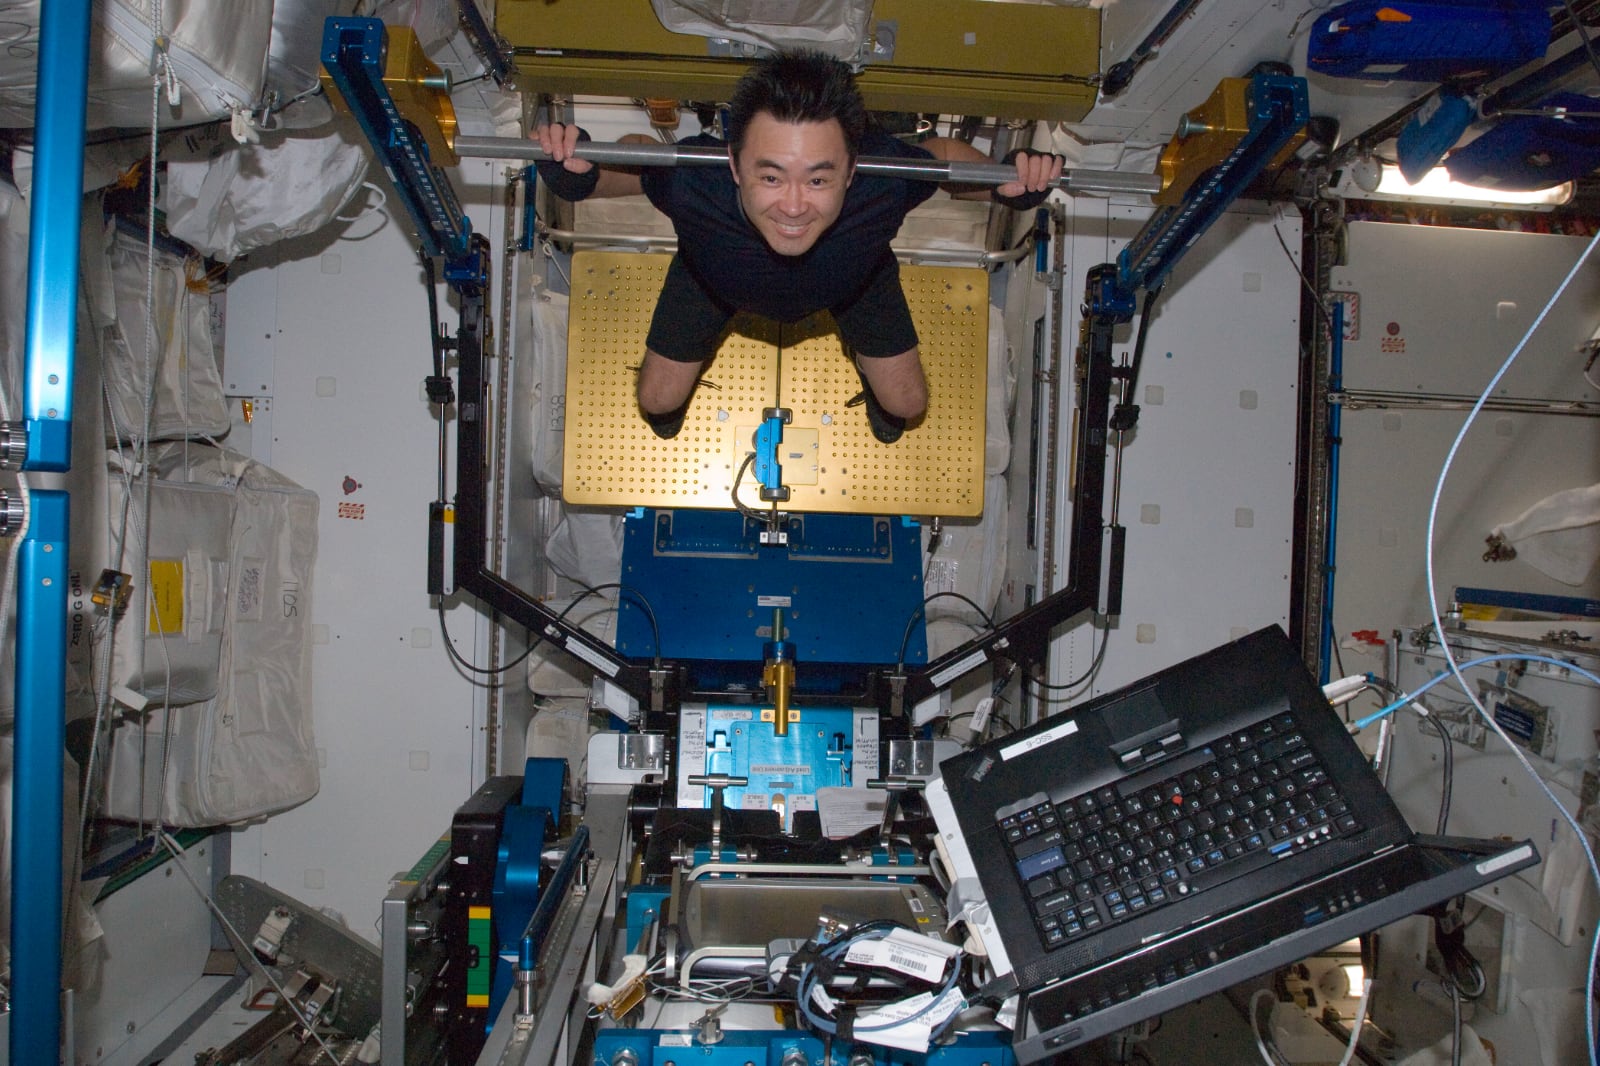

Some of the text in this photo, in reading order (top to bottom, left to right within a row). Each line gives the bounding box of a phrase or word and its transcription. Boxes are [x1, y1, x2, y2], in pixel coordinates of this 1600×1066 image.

[73, 600, 82, 609] G
[282, 581, 298, 617] 1105
[69, 613, 83, 646] ZERO
[1026, 733, 1053, 748] SSC-6
